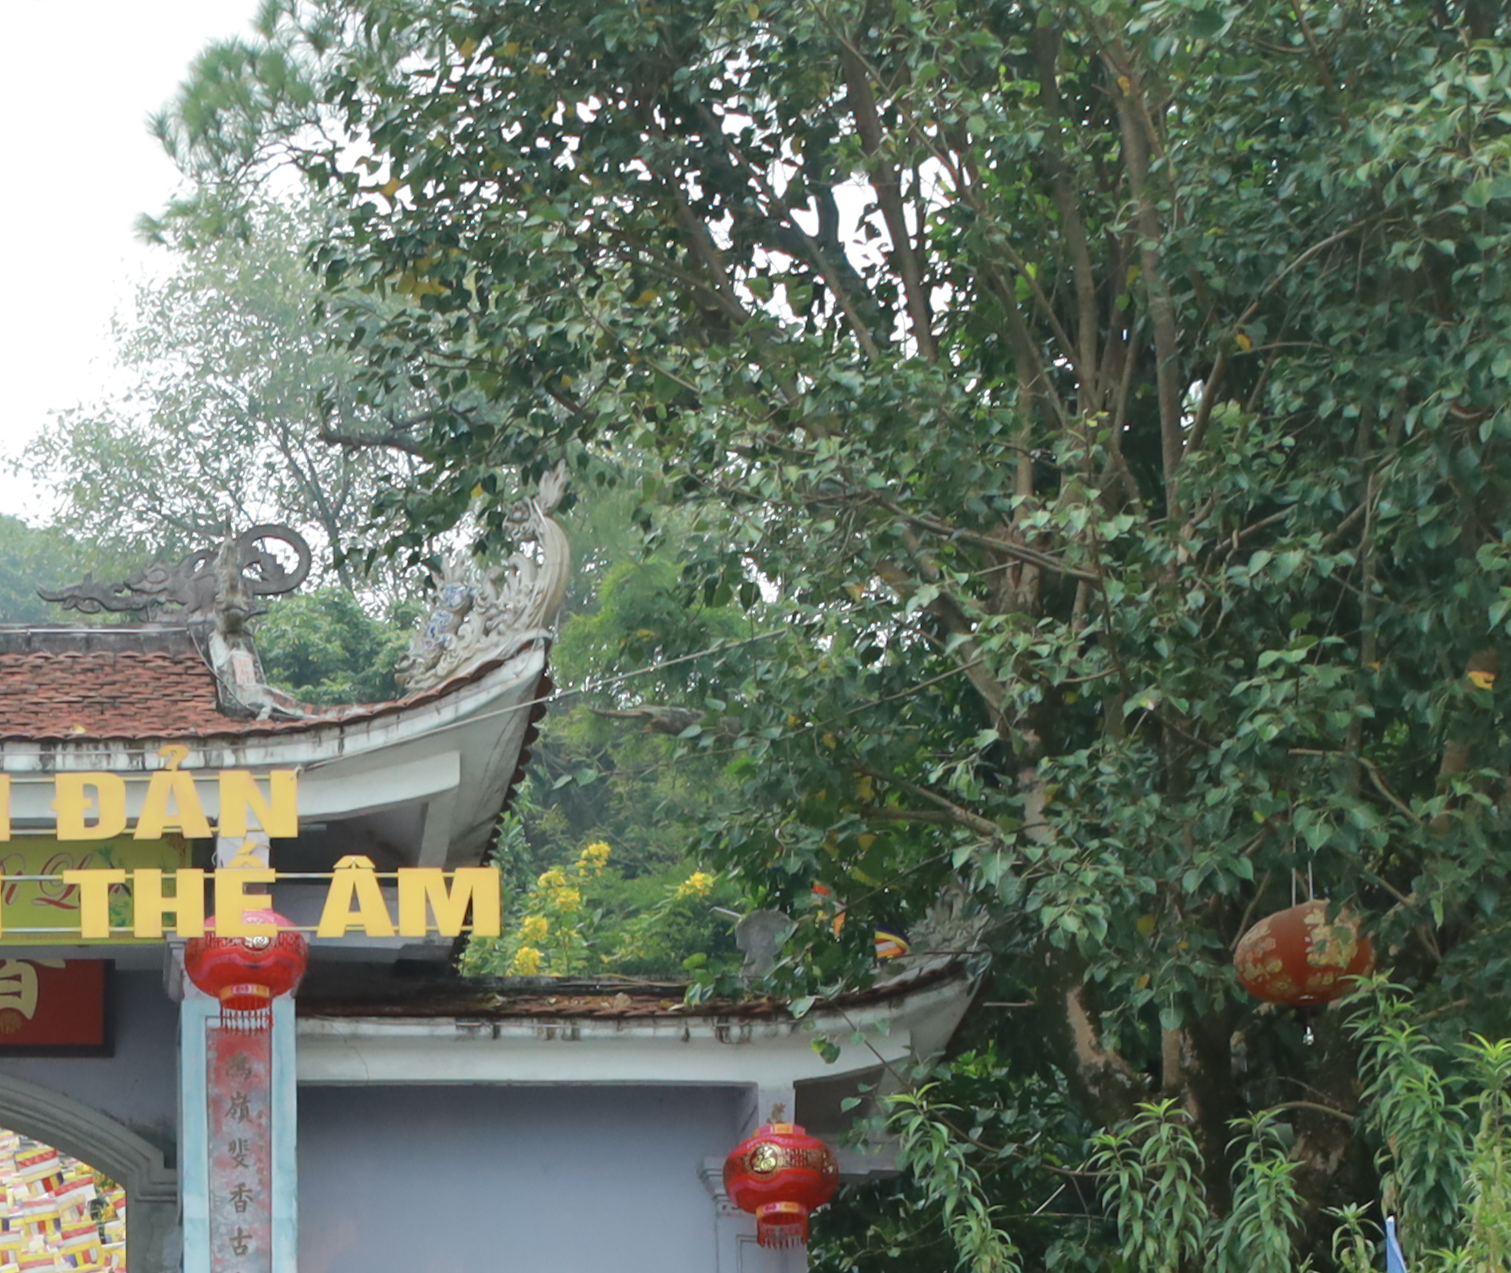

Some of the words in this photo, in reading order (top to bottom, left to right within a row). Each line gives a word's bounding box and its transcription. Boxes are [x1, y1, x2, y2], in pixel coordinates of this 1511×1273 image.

[52, 744, 299, 840] ĐẢN
[62, 841, 278, 939] THẾ
[316, 855, 501, 938] ÂM
